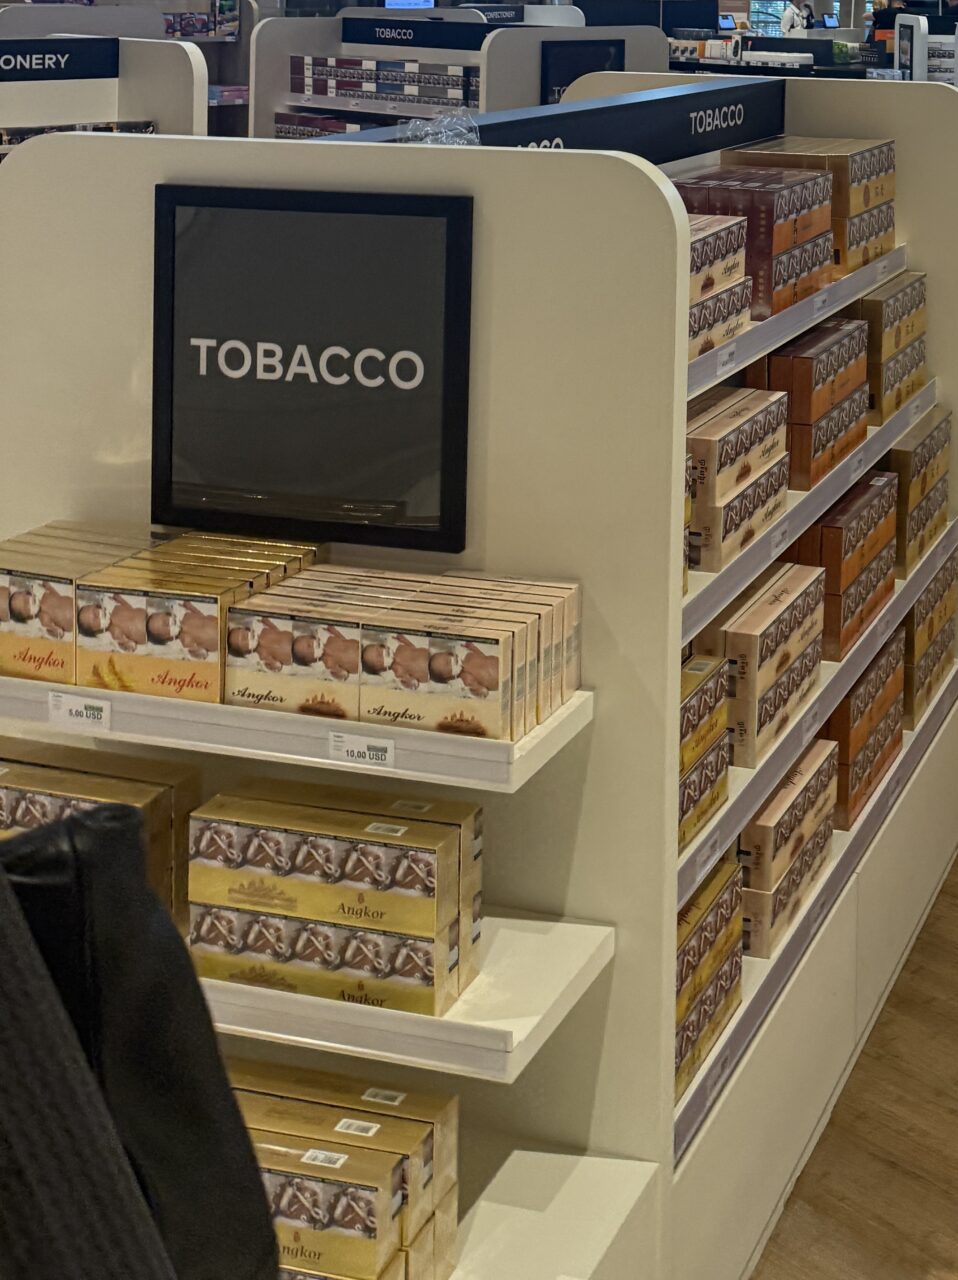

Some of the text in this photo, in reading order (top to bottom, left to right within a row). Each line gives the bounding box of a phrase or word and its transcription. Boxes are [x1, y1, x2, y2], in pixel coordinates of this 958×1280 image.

[375, 27, 414, 40] TOBACCO
[689, 103, 744, 135] TOBACCO
[190, 337, 425, 391] TOBACCO
[13, 647, 66, 671] Angkor
[151, 670, 211, 694] Angkor
[231, 686, 287, 705] Angkor
[85, 711, 103, 721] USD
[367, 705, 425, 722] Angkor
[345, 748, 387, 762] 10,00 USD
[337, 902, 386, 920] Angkor
[282, 1245, 322, 1261] ngkor
